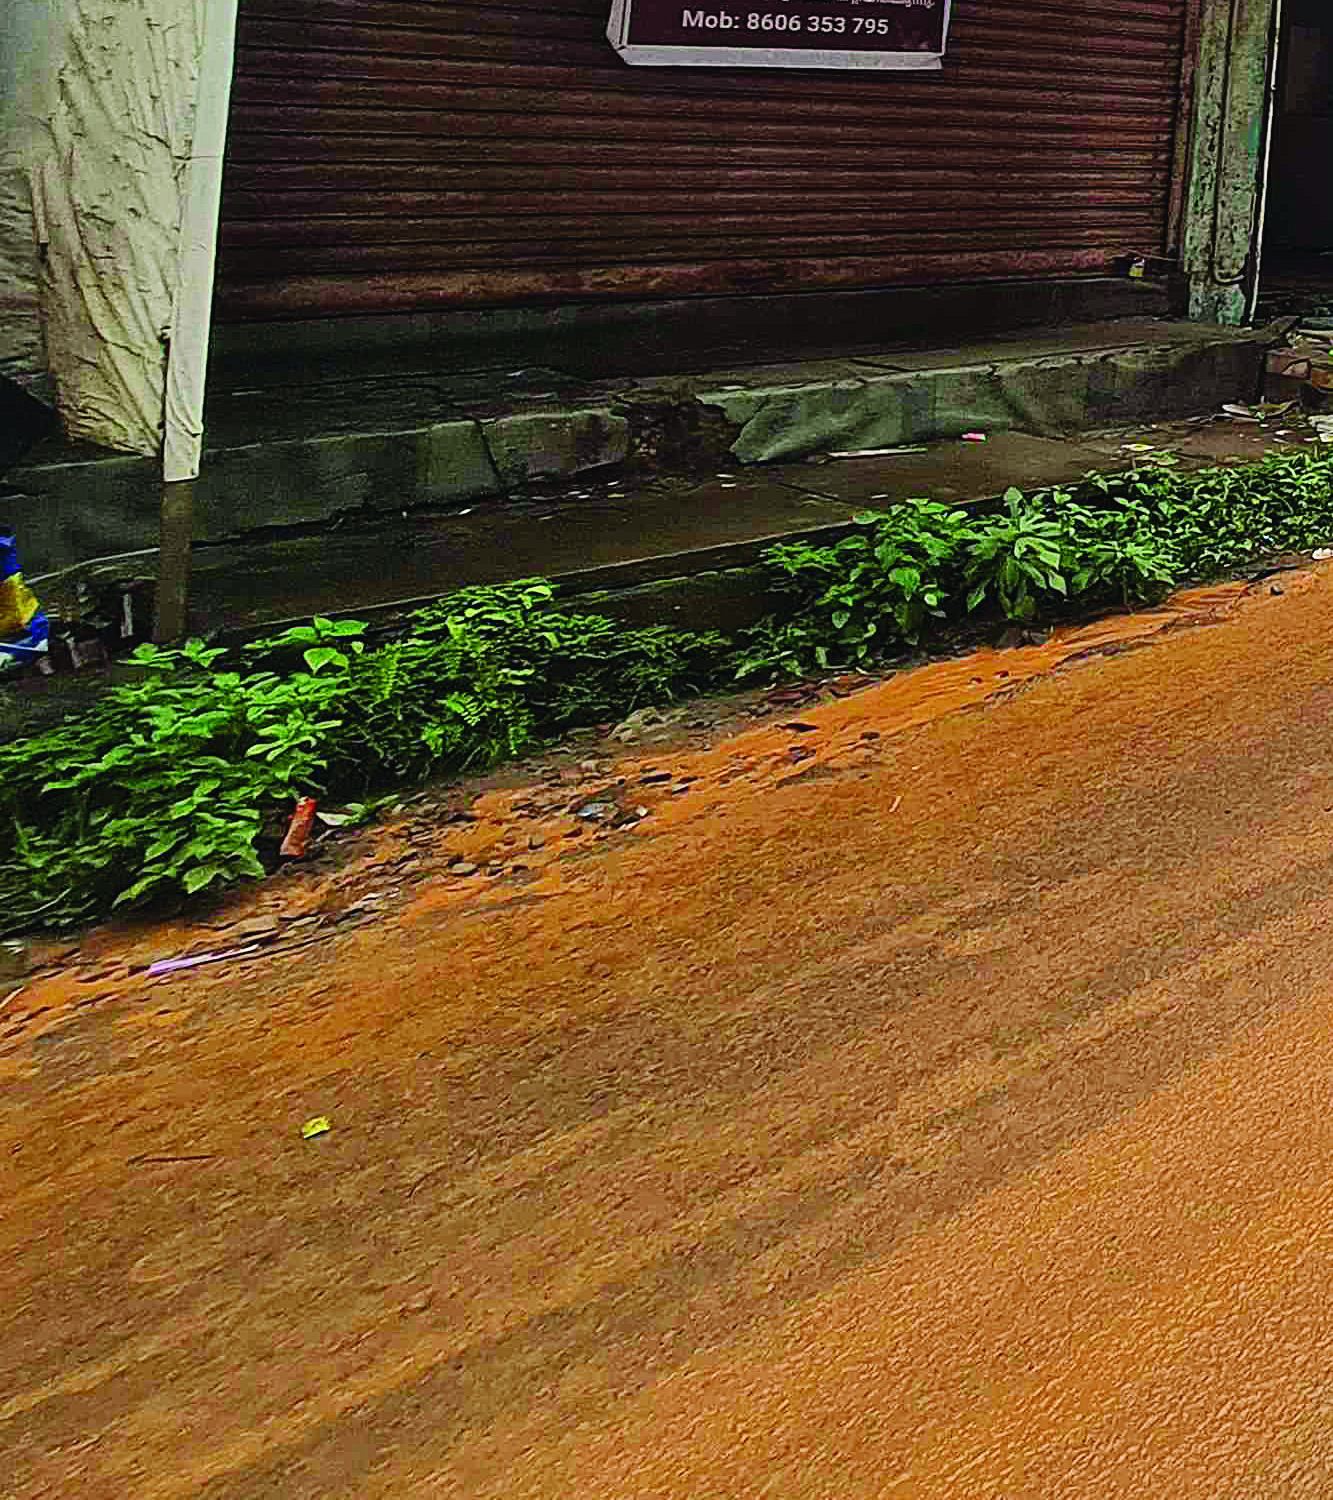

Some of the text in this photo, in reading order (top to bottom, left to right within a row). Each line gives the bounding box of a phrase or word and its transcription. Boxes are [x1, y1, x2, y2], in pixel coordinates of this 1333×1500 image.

[681, 9, 889, 35] Mob: 8606 353 795
